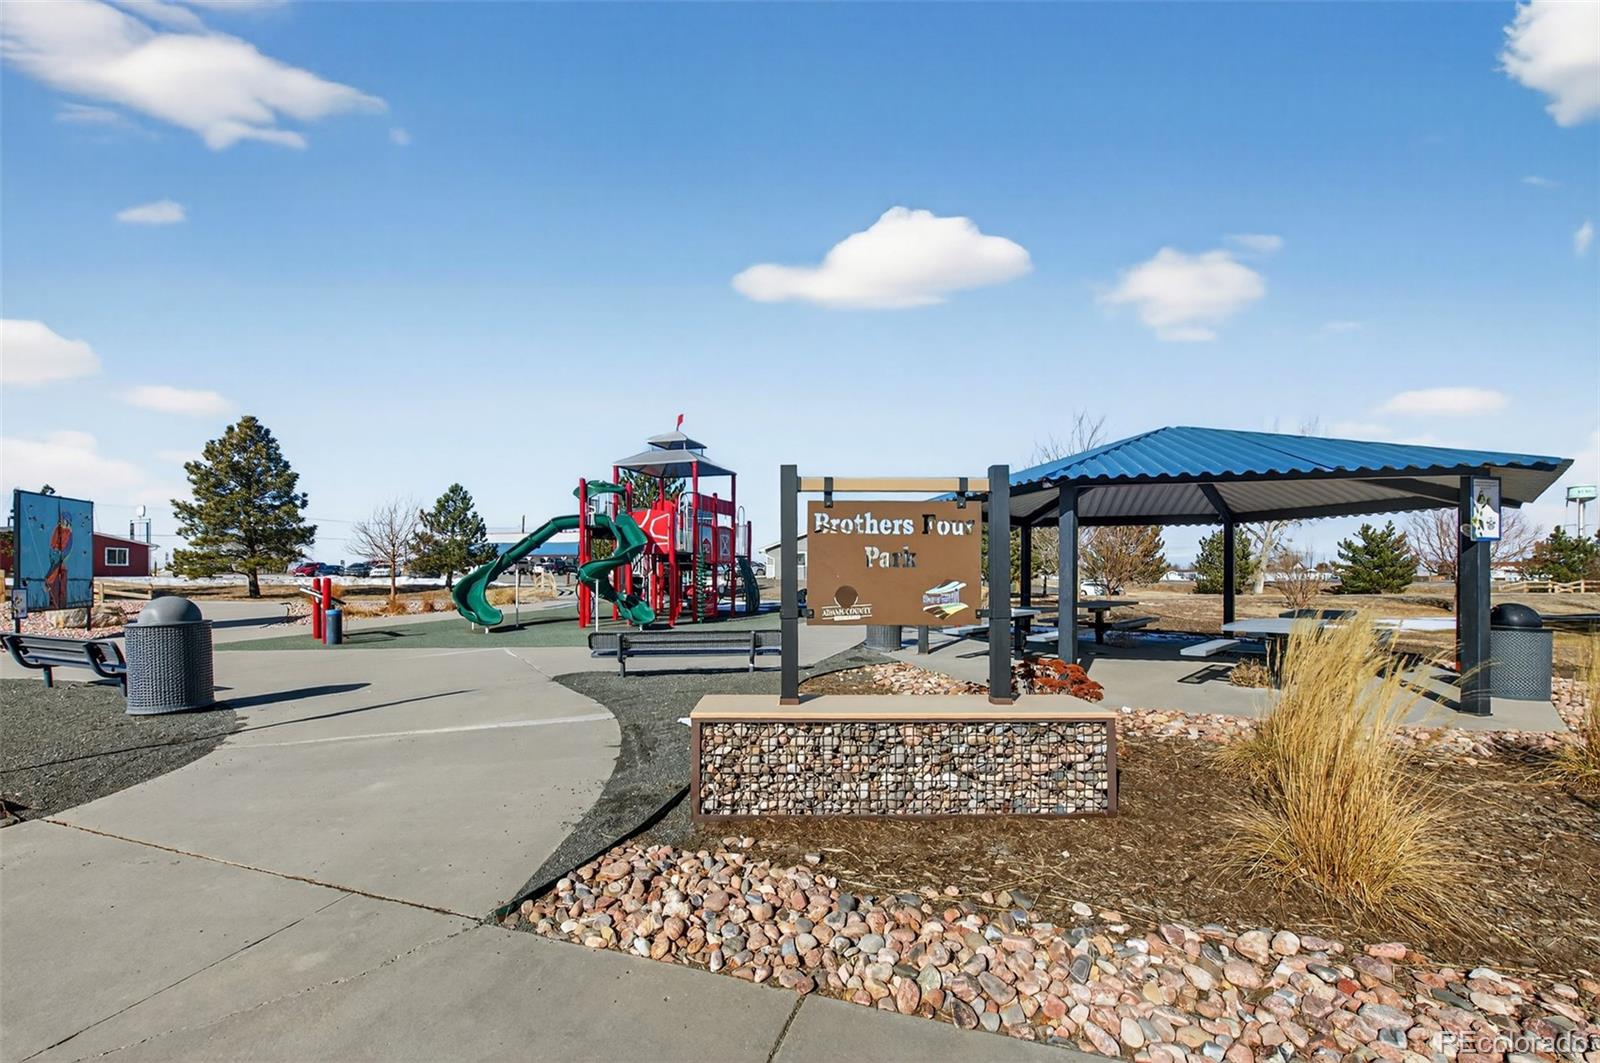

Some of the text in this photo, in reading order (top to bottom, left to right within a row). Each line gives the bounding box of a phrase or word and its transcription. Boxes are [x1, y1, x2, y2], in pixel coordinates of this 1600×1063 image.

[814, 512, 975, 535] Brothers Four
[864, 546, 917, 568] Park
